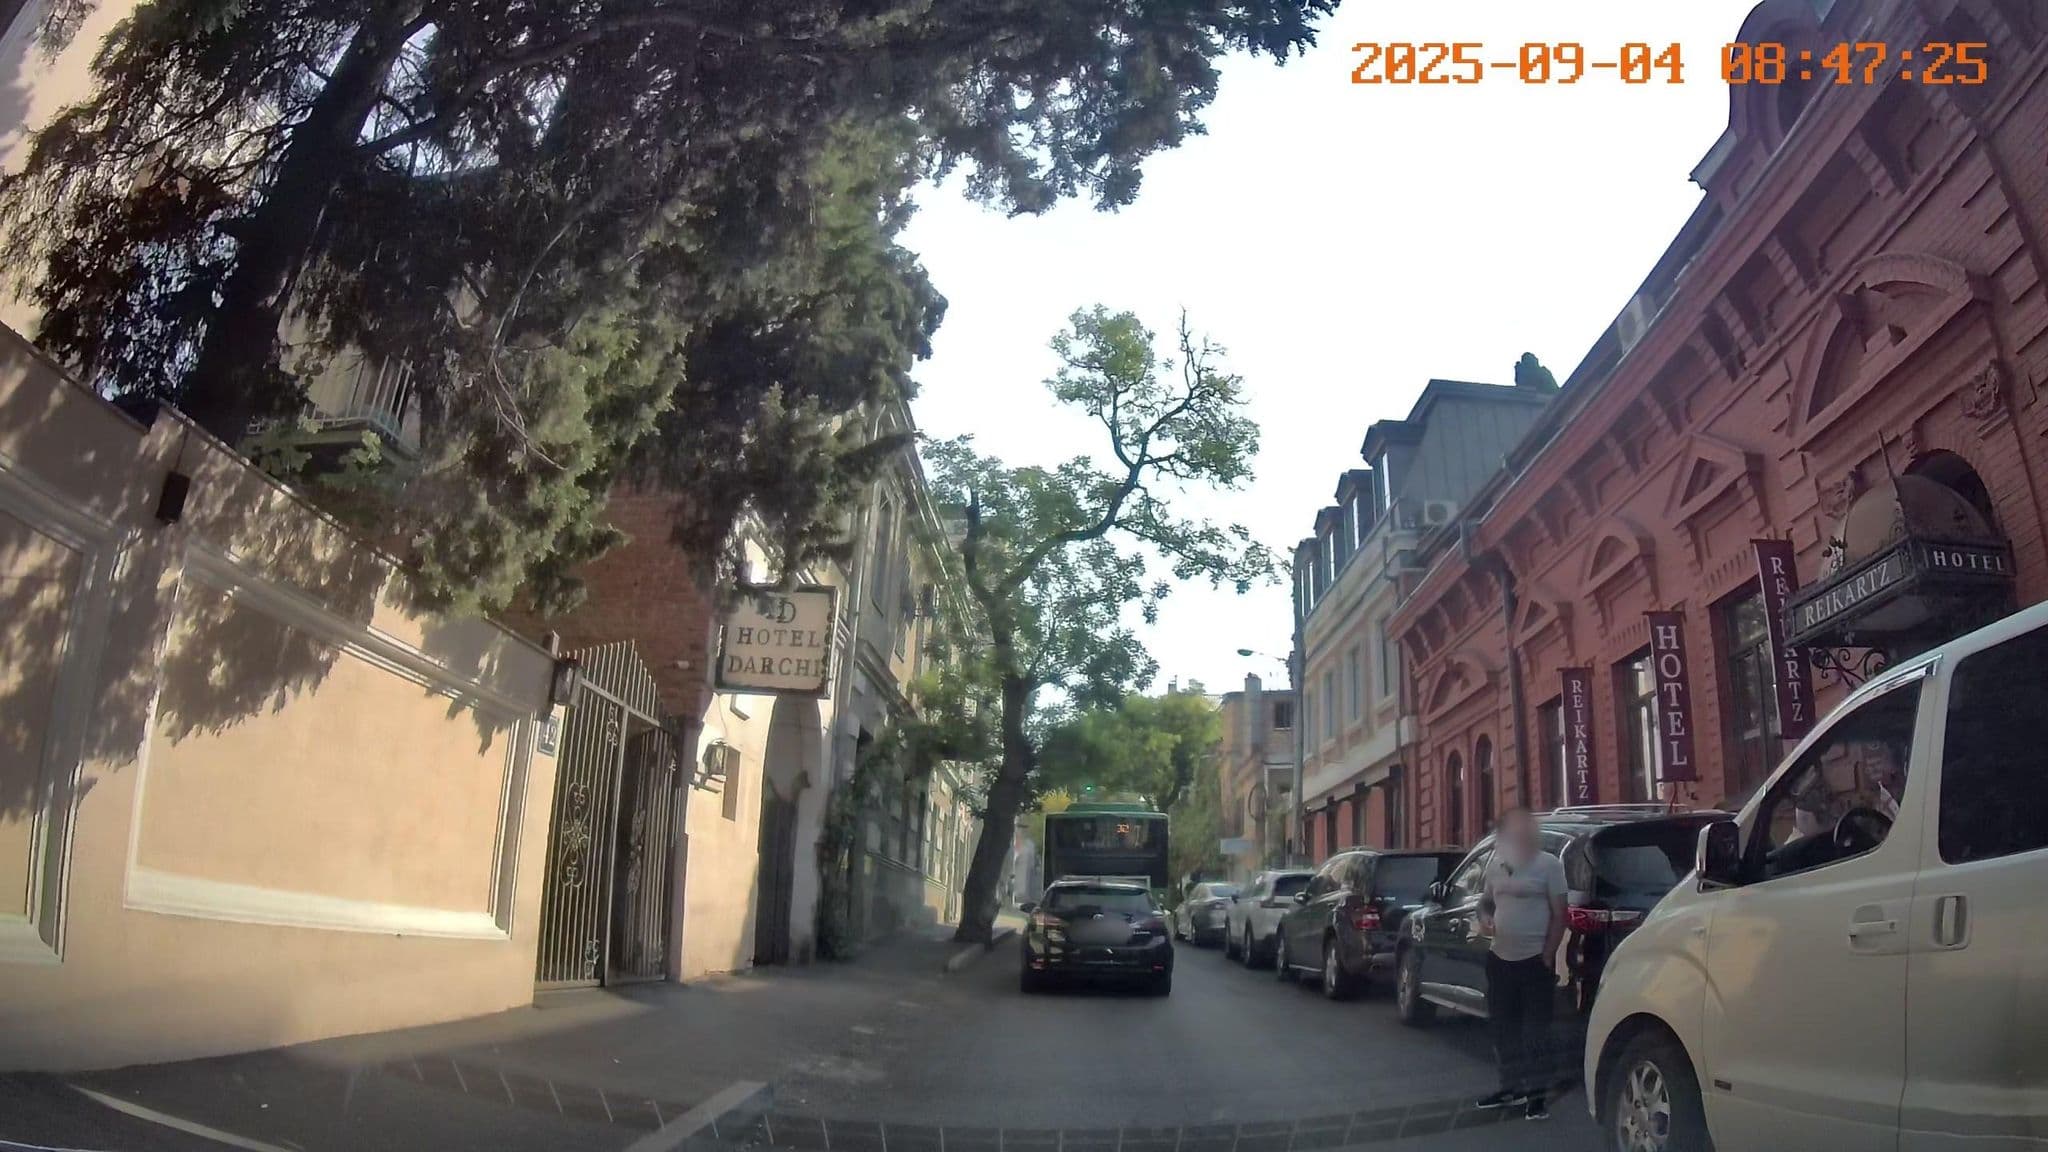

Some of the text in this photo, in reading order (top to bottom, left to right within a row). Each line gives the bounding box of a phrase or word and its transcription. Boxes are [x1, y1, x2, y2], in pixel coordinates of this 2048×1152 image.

[1934, 550, 2006, 572] HOTEL
[1804, 561, 1892, 627] REIKARTZ
[736, 626, 820, 648] HOTEL
[726, 655, 822, 678] DARCHI
[1655, 625, 1688, 766] HOTEL
[1570, 679, 1589, 799] REIKARTZ
